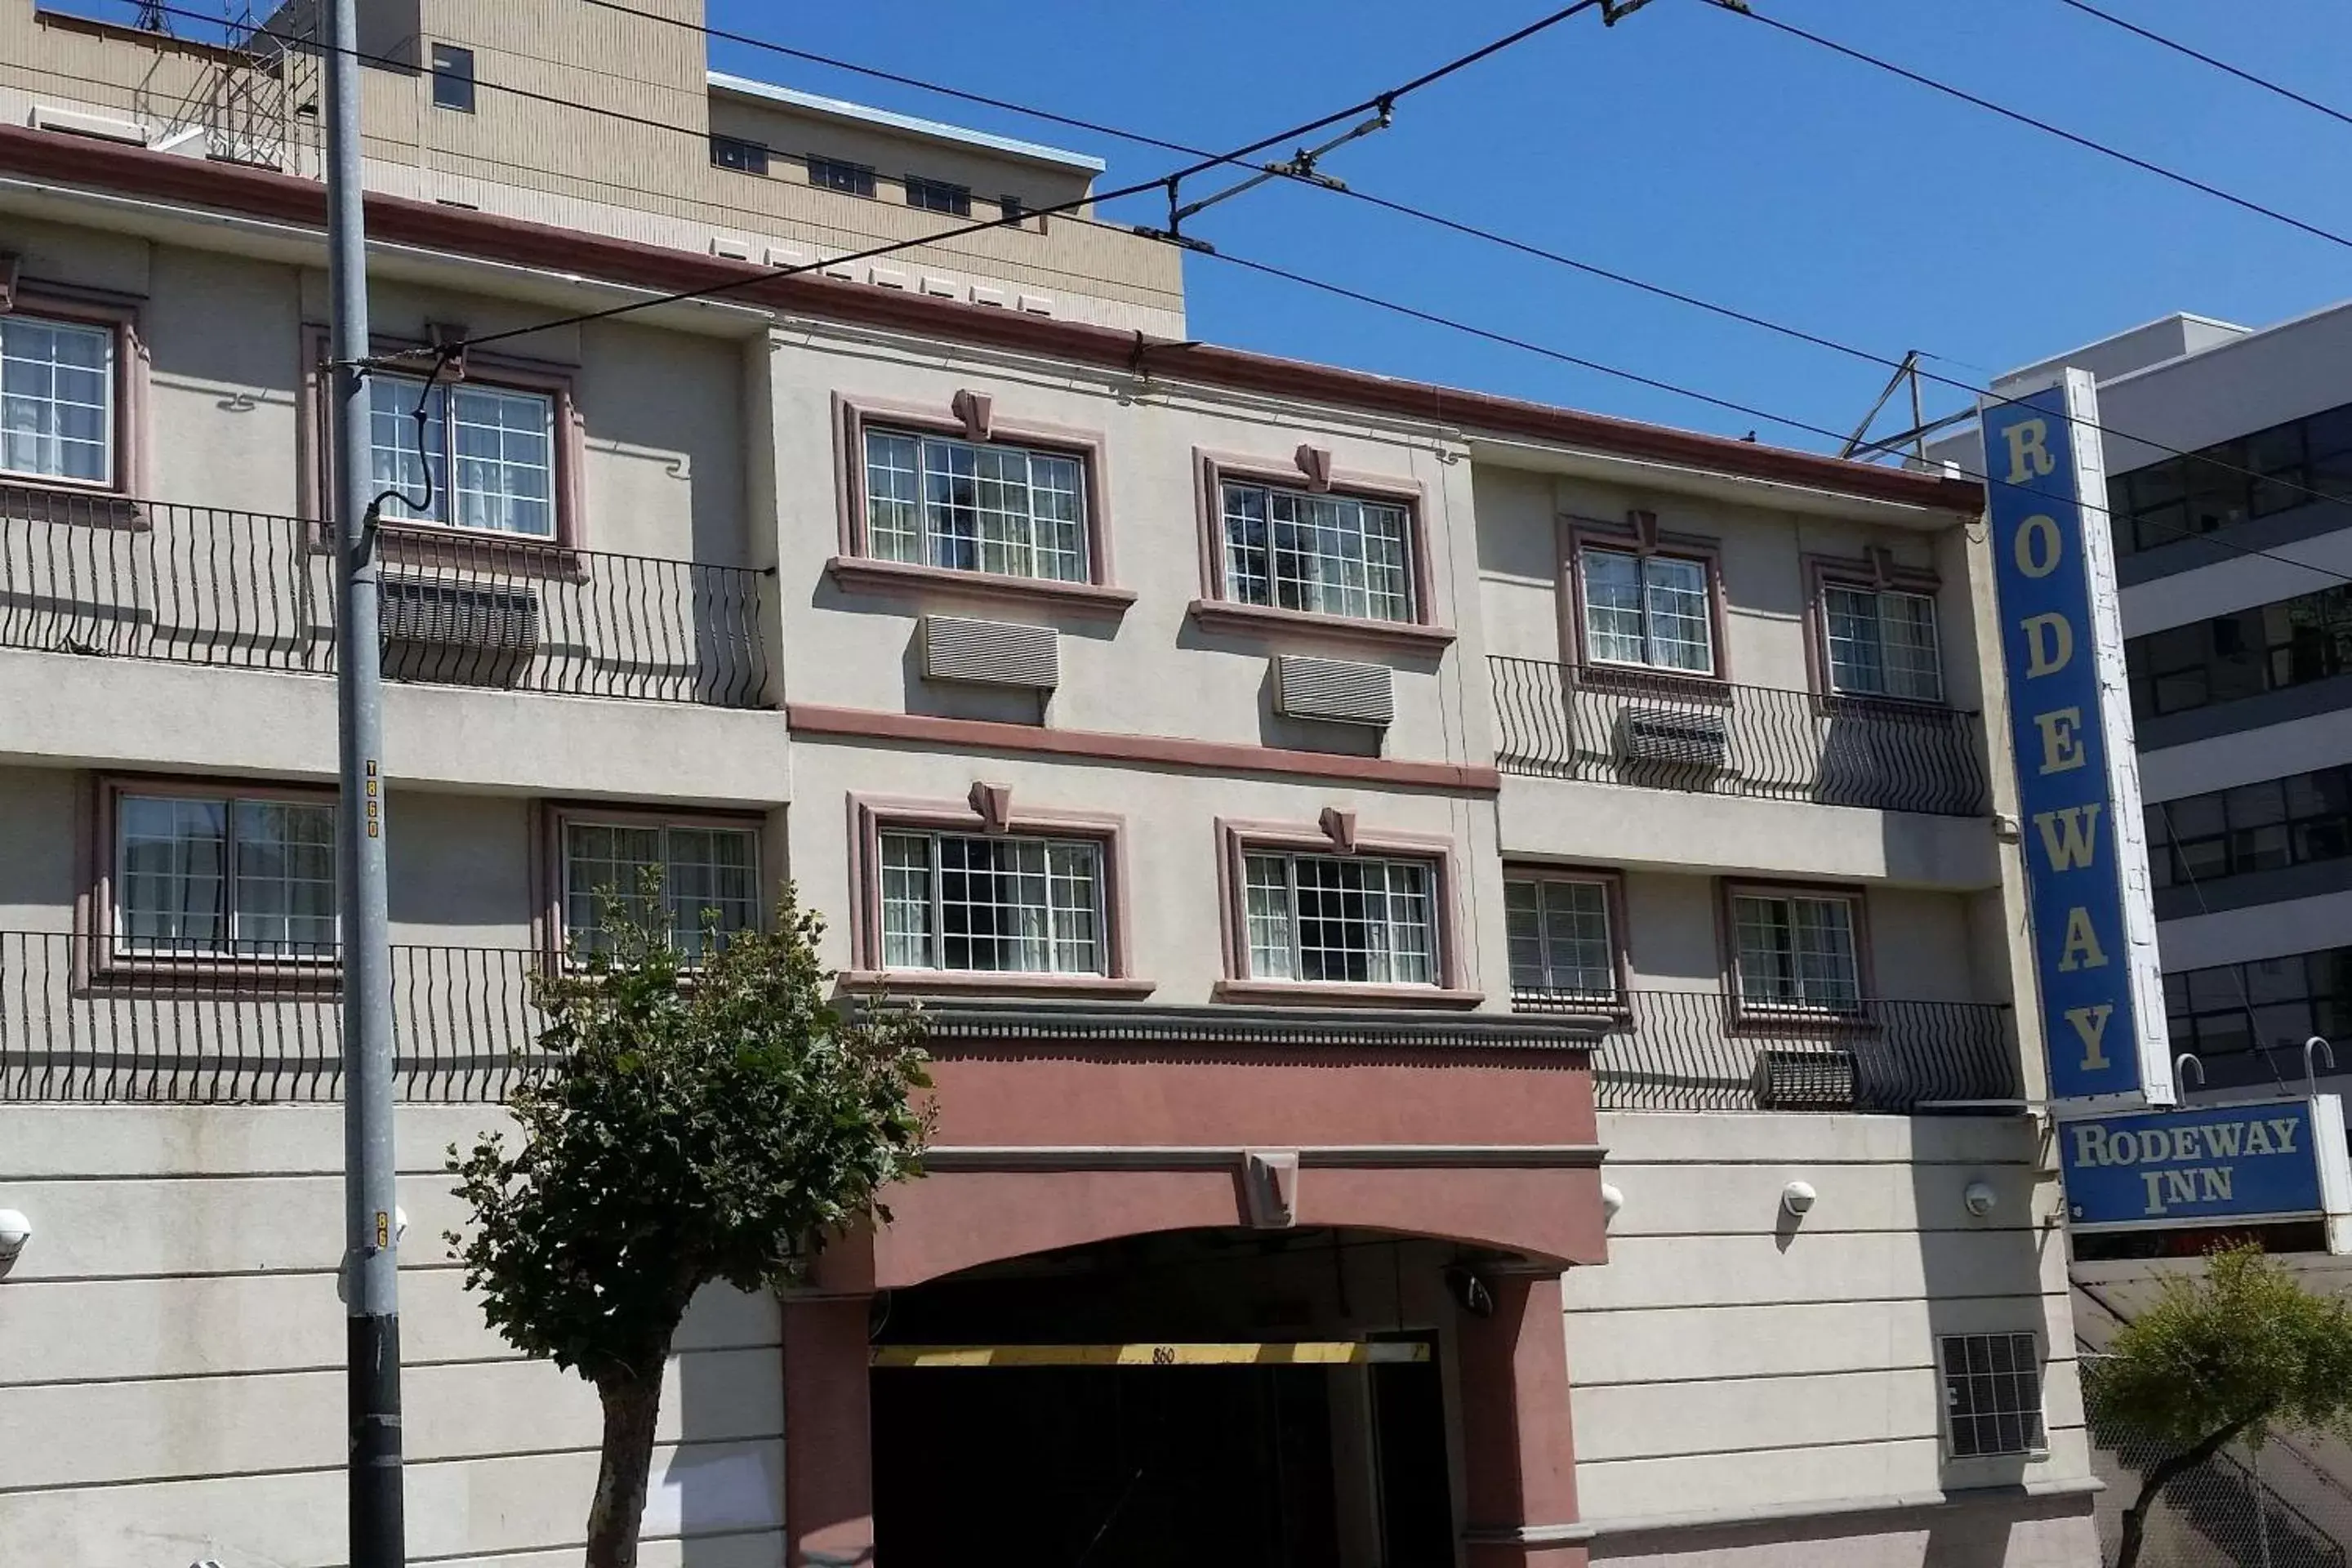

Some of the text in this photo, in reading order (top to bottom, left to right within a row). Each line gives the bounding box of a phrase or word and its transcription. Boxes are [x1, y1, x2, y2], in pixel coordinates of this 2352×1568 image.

[2001, 418, 2114, 1071] RODEWAY
[2073, 1117, 2301, 1168] RODEWAY
[2140, 1166, 2234, 1215] INN
[1152, 1347, 1175, 1363] 860
